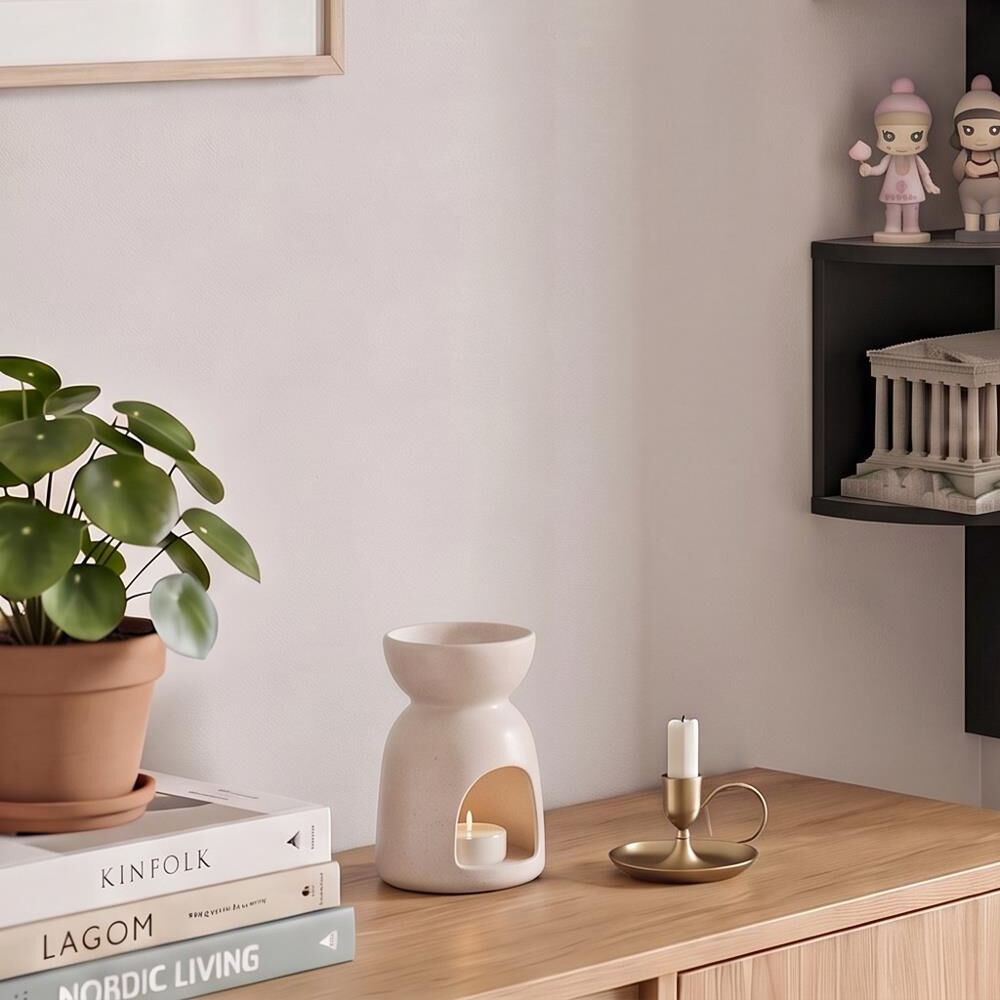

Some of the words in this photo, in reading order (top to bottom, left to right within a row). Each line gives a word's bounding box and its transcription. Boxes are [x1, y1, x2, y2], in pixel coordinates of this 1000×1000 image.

[101, 848, 211, 888] KINFOLK
[43, 912, 154, 960] LAGOM
[58, 964, 167, 1000] NORDIC
[175, 944, 260, 987] LIVING
